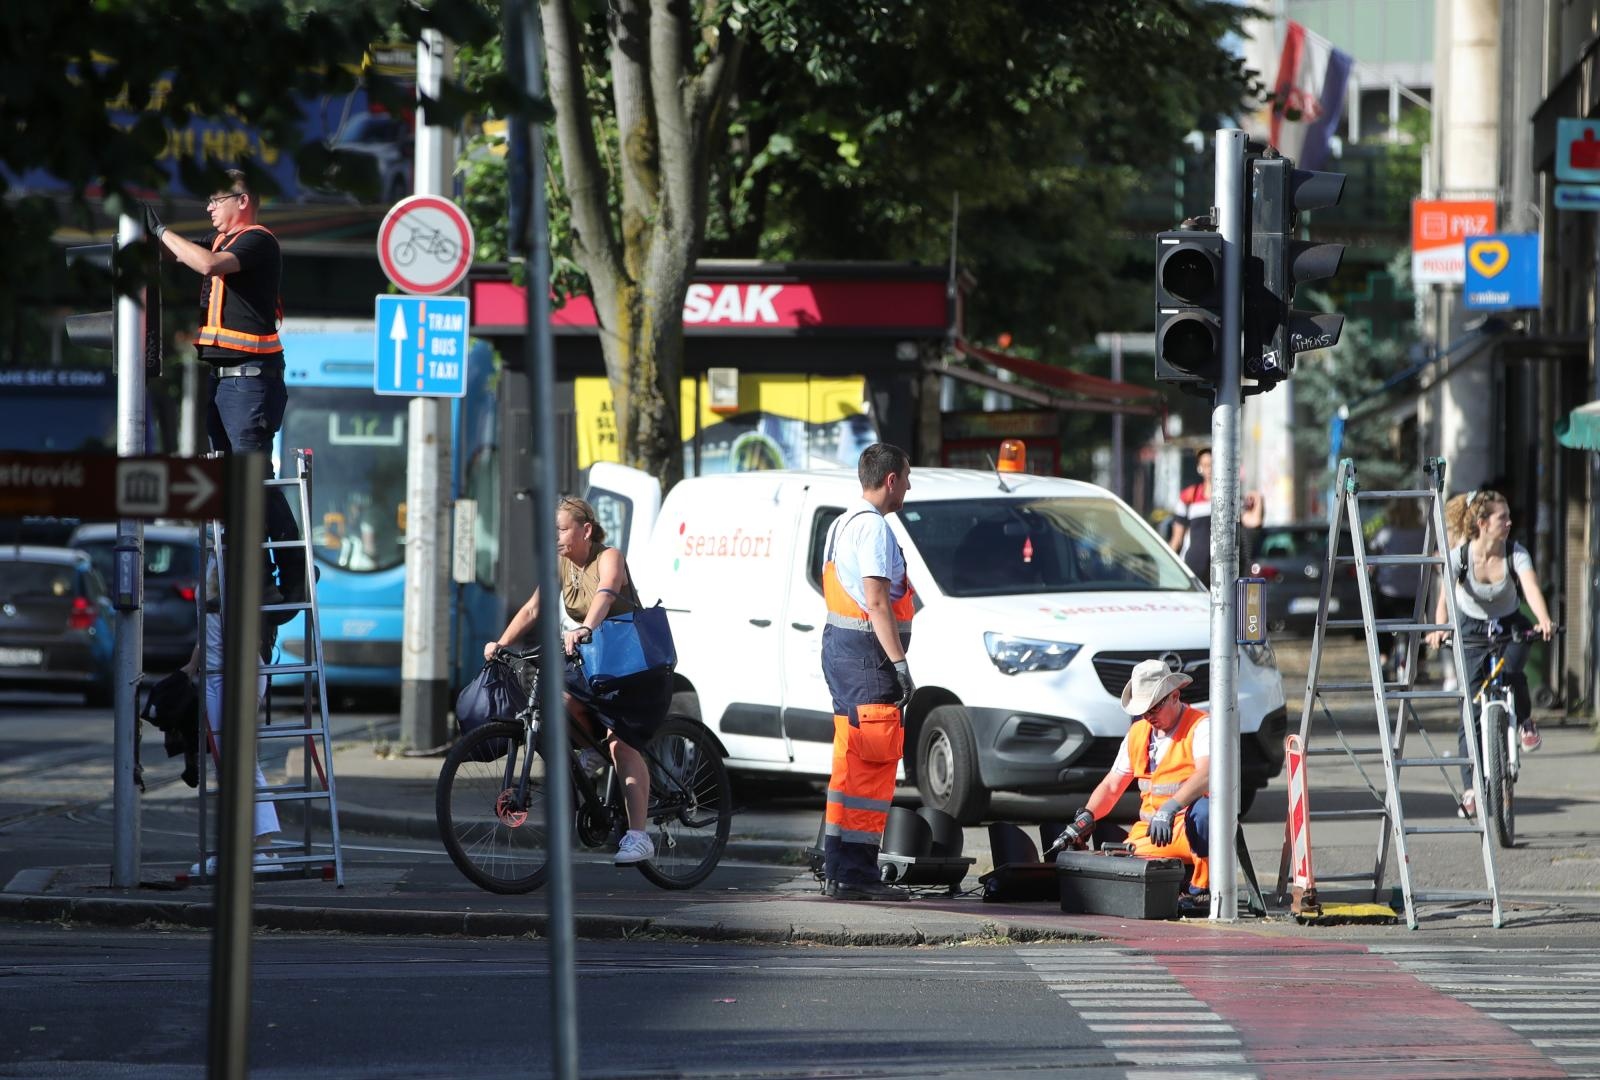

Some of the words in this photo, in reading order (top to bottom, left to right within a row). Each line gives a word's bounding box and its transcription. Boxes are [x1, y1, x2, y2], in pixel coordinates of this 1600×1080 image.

[682, 283, 784, 323] SAK
[428, 313, 463, 332] TRAM
[431, 337, 457, 357] BUS
[429, 361, 459, 380] TAXI
